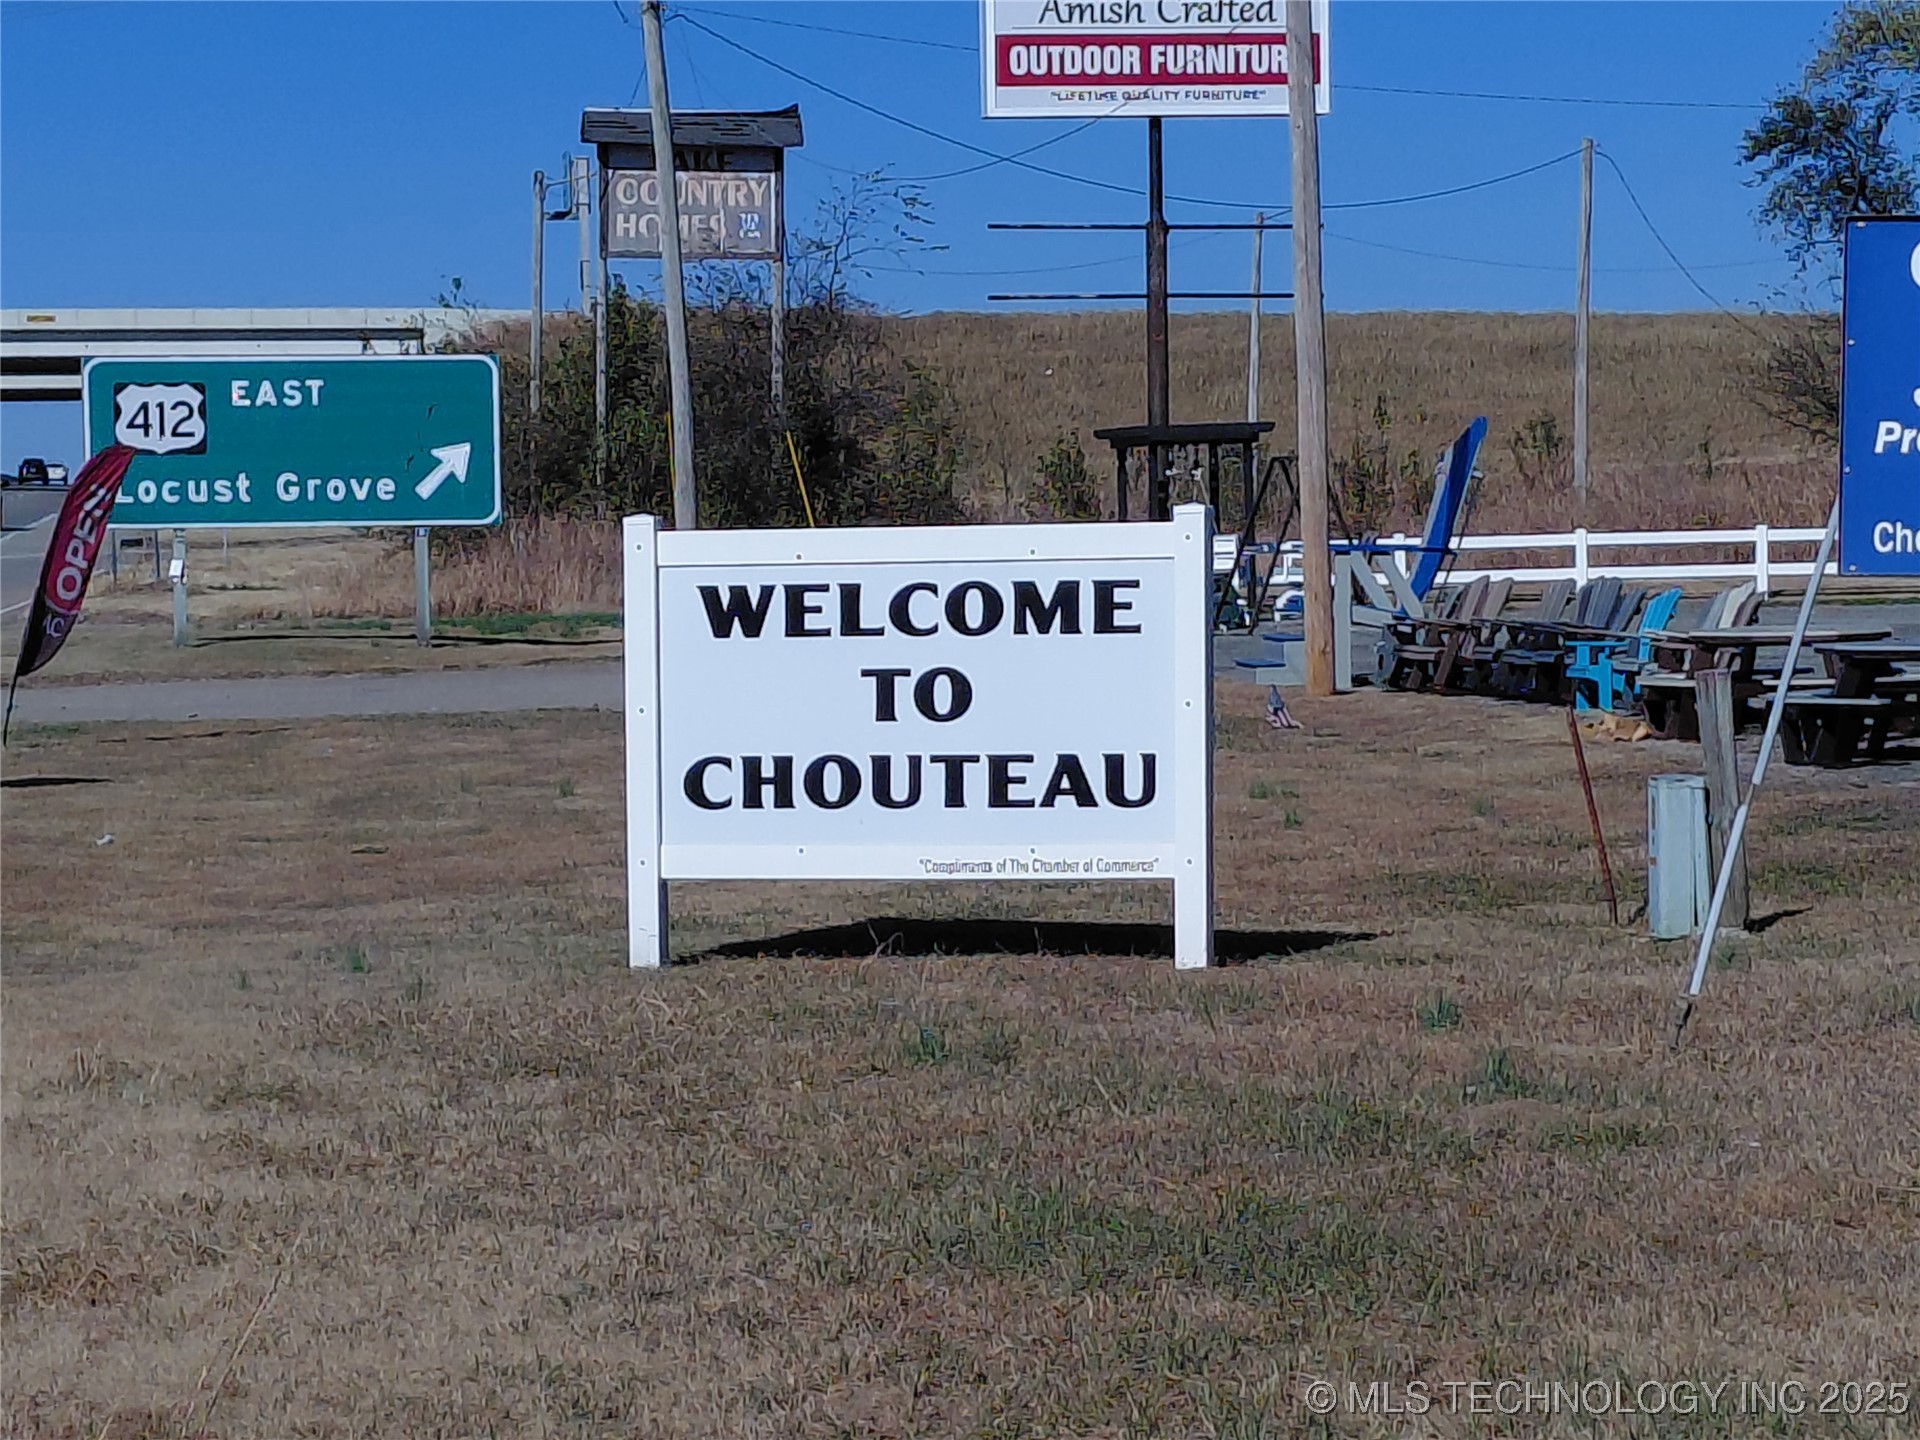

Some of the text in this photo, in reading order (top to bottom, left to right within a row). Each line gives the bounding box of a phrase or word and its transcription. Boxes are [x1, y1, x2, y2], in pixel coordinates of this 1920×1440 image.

[1039, 0, 1278, 24] Amish Crafted
[1008, 44, 1289, 76] OUTDOOR FURNITUR
[230, 379, 325, 408] EAST
[125, 400, 197, 441] 412
[115, 472, 396, 504] Locust Grove
[696, 579, 1142, 638] WELCOME
[861, 667, 973, 722] TO
[683, 753, 1157, 809] CHOUTEAU
[996, 858, 1007, 873] of
